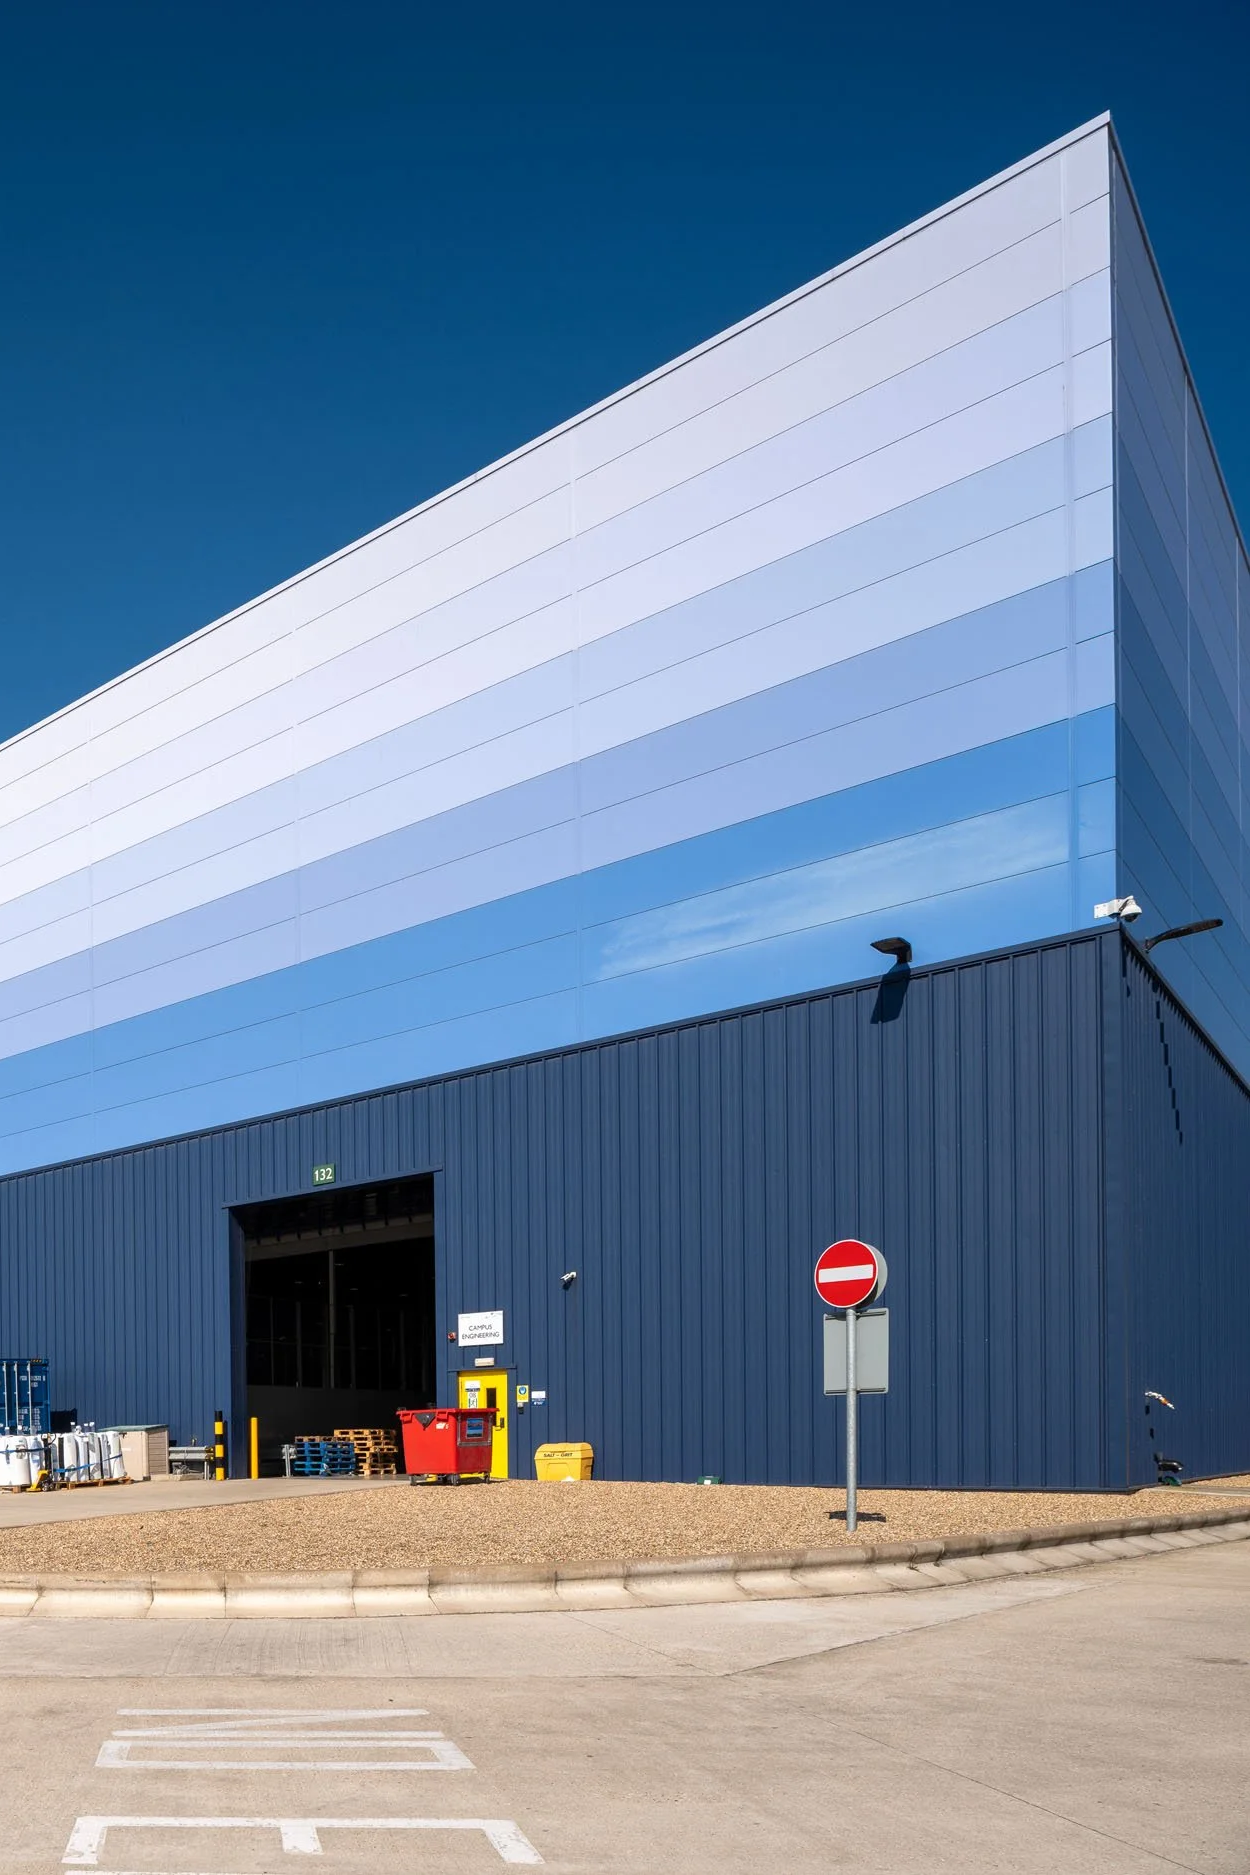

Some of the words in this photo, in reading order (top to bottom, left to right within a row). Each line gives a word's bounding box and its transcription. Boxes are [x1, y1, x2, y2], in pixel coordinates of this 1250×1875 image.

[314, 1167, 333, 1182] 132
[468, 1324, 493, 1332] CAMPUS
[461, 1331, 500, 1340] ENGINEERING
